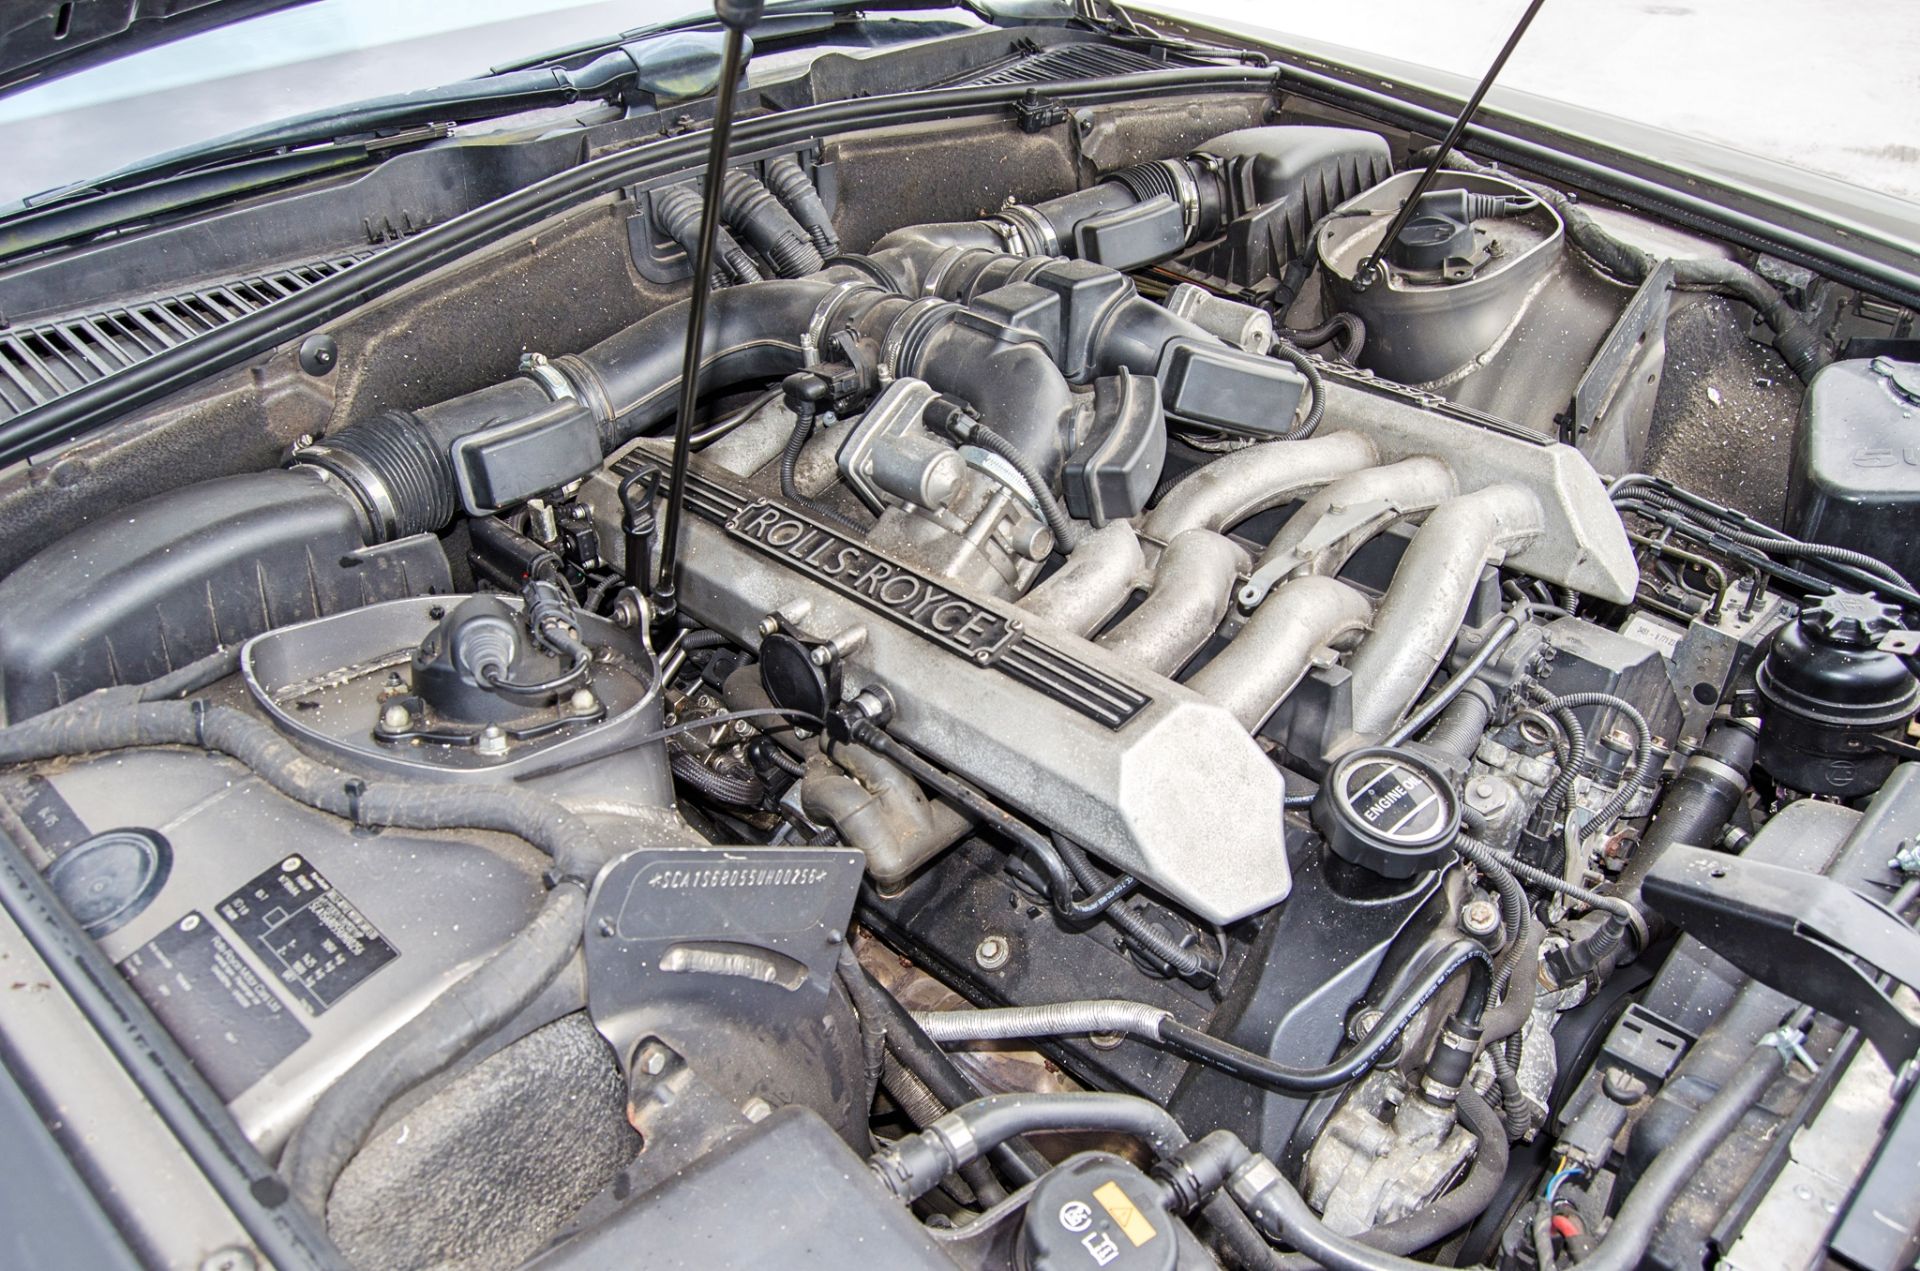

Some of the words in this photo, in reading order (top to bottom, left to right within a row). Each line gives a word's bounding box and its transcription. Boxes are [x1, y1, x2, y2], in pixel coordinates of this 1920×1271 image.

[746, 508, 998, 647] ROLLS-ROYCE
[1364, 784, 1407, 822] ENGINE
[1402, 775, 1423, 791] OIL
